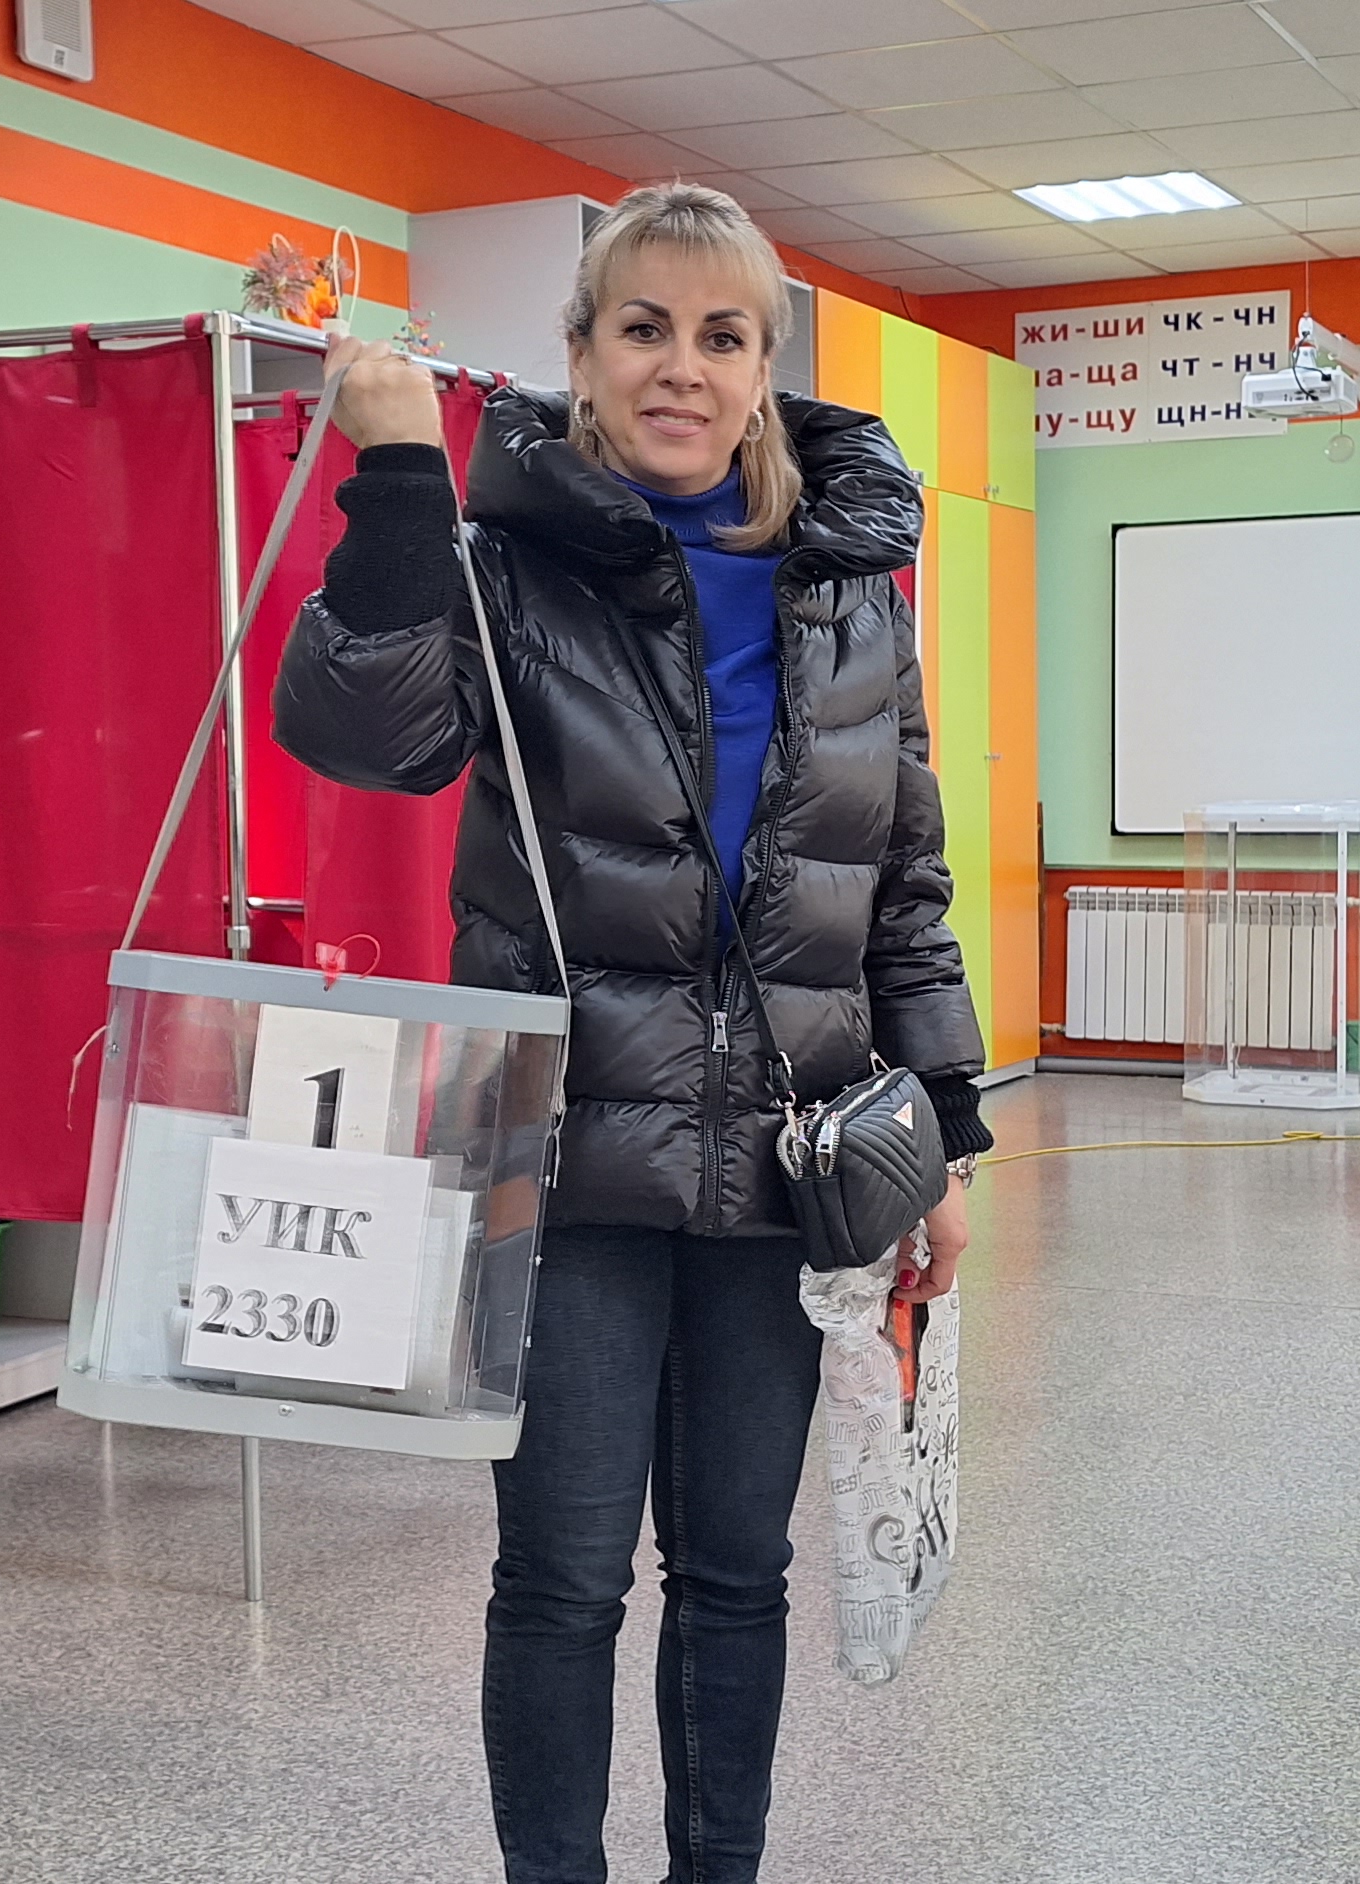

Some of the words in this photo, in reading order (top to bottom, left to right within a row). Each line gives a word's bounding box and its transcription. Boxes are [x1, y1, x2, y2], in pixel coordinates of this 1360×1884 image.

[304, 1067, 345, 1149] 1
[214, 1192, 372, 1259] УИК
[196, 1283, 340, 1348] 2330
